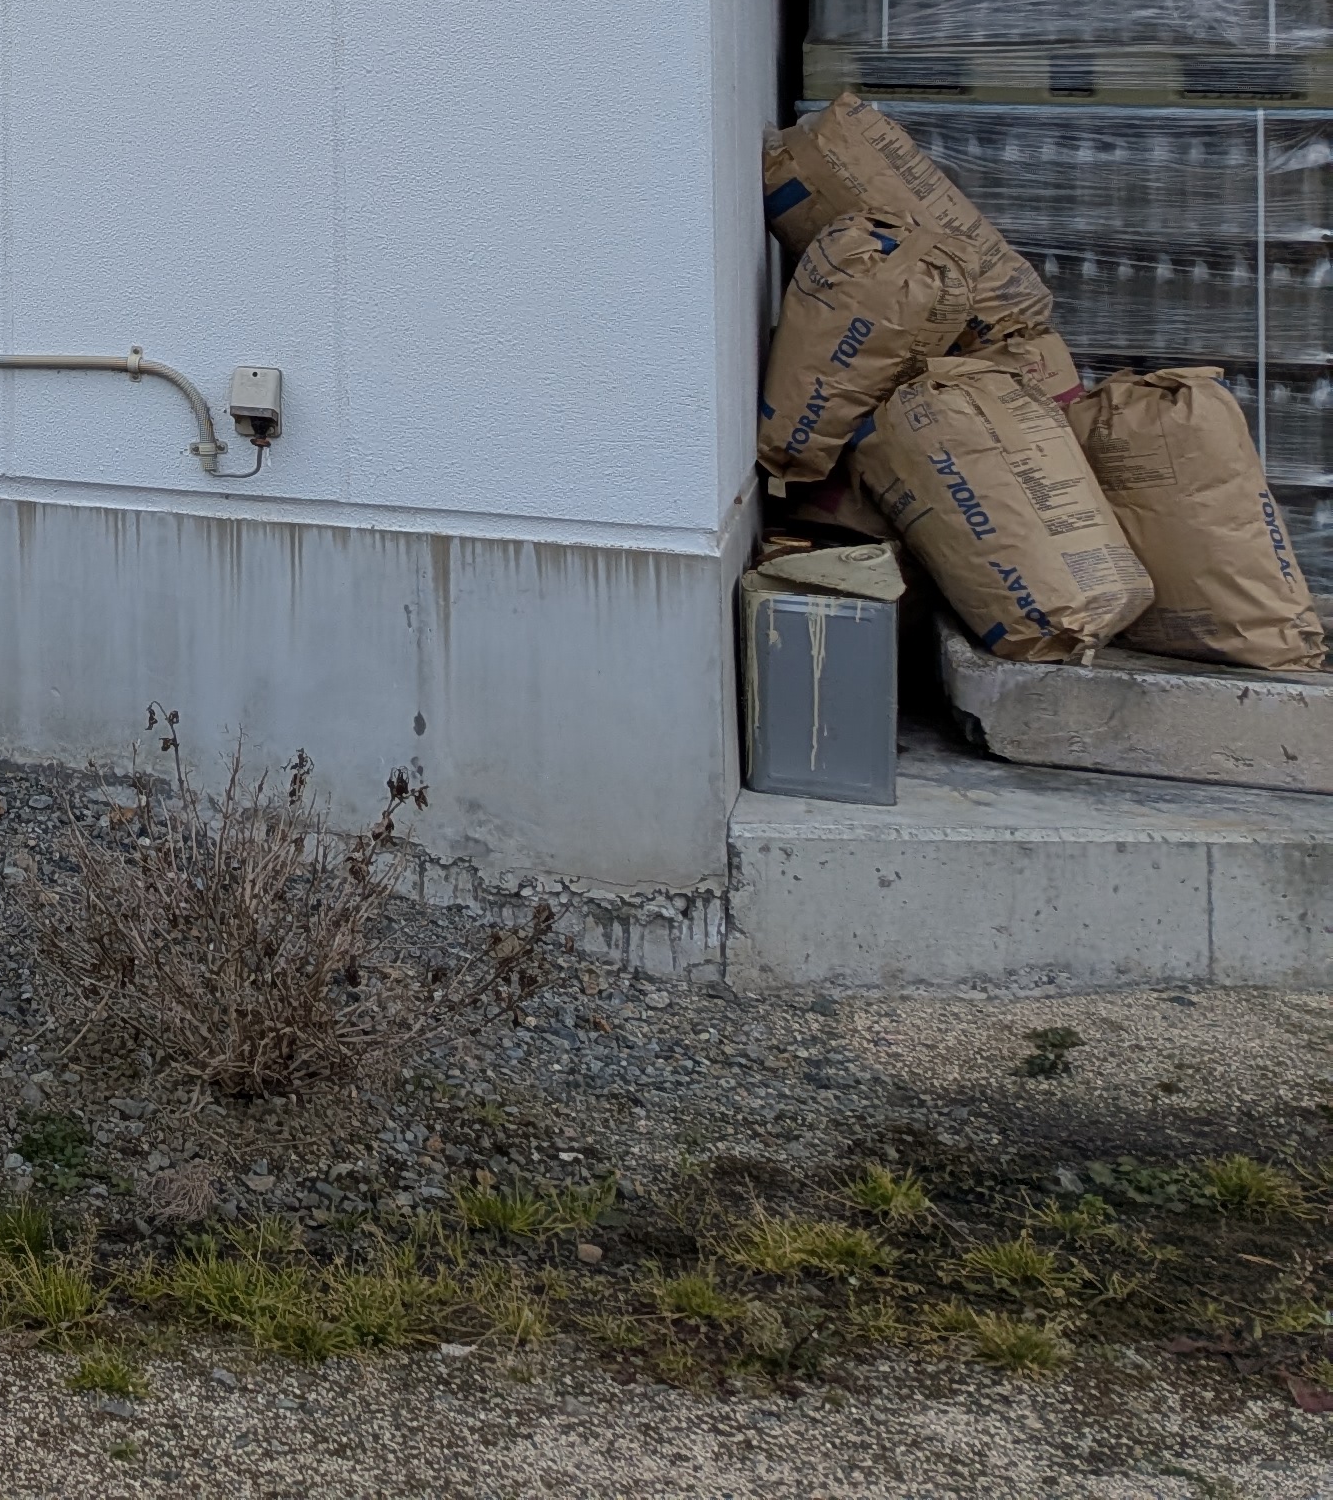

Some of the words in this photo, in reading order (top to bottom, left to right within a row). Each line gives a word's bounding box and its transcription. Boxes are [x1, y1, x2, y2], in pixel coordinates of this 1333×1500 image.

[830, 316, 875, 369] TOYO
[786, 381, 830, 455] TORAY
[927, 447, 997, 541] TOYOLAC
[1258, 489, 1297, 584] TOYOLAC
